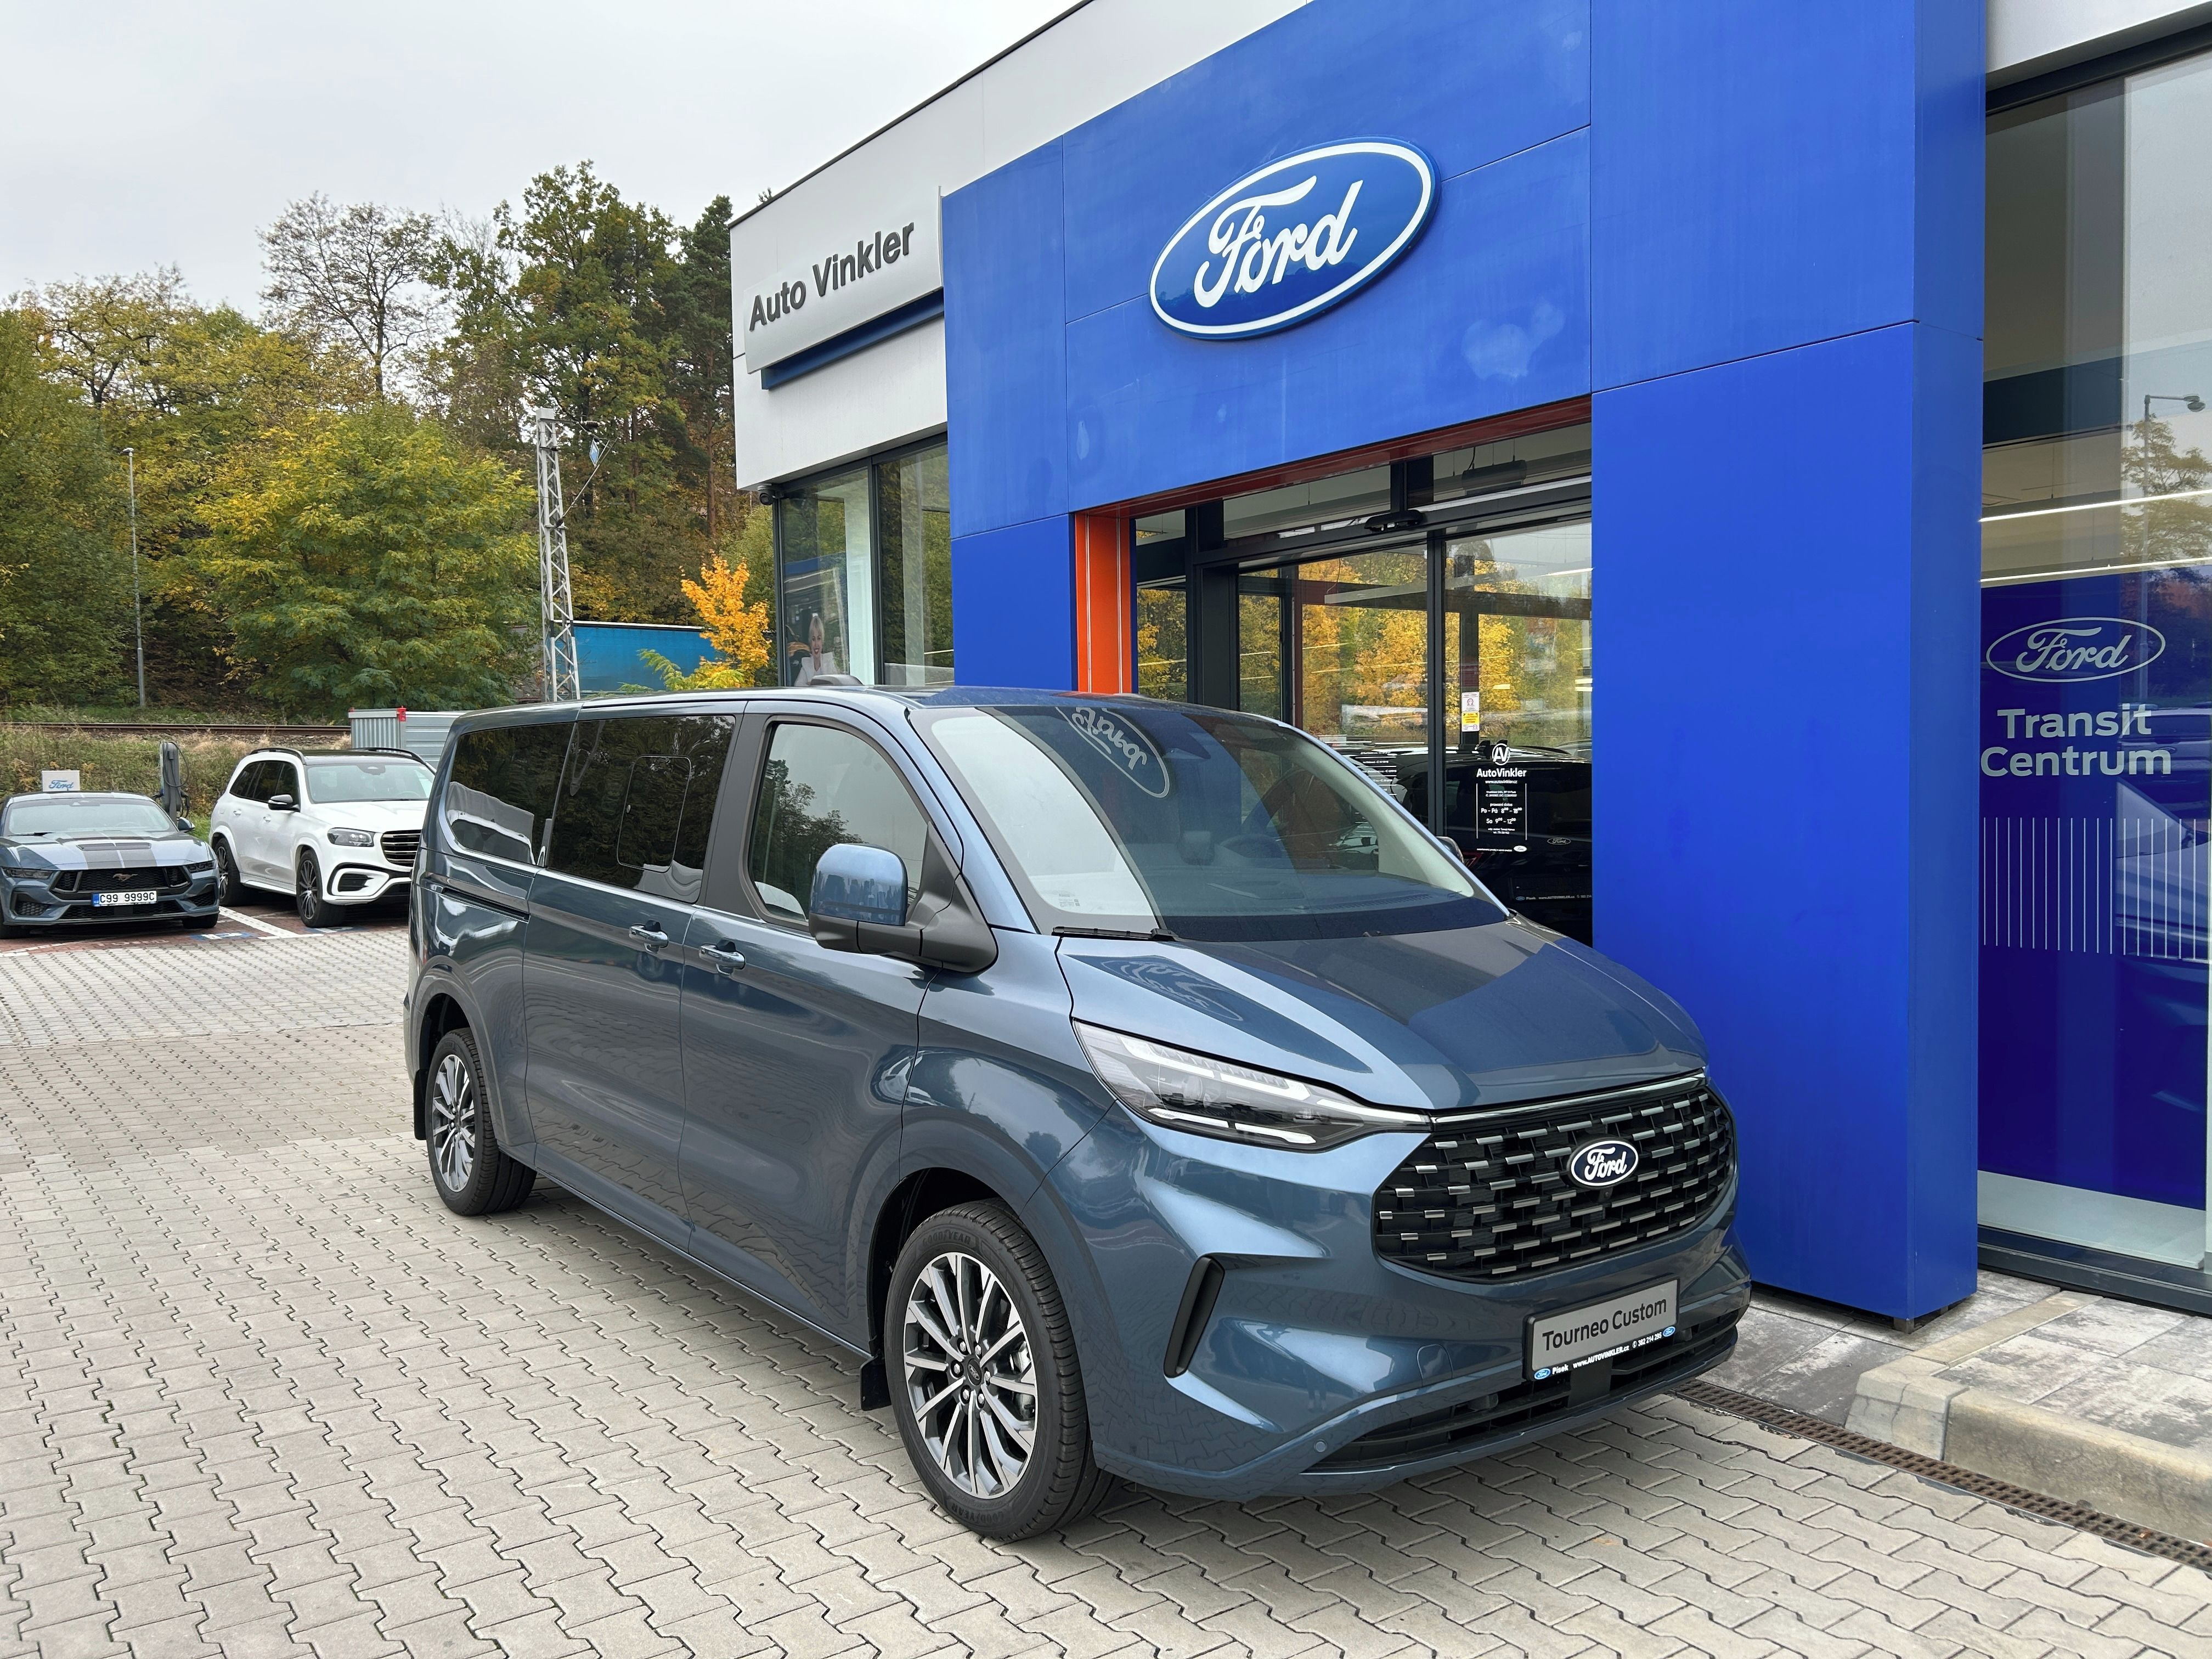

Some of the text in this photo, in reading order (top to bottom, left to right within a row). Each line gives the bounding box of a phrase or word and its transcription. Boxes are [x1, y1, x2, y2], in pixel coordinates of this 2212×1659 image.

[1194, 175, 1364, 308] Ford
[749, 222, 914, 332] Auto Vinkler
[2016, 627, 2132, 673] Ford
[1997, 703, 2152, 738] Transit
[1476, 768, 1527, 777] AutoVinkler
[1980, 746, 2171, 777] Centrum
[48, 780, 74, 789] Ford
[100, 893, 155, 903] C99 9999C
[1584, 1147, 1627, 1181] Ford
[1542, 1299, 1667, 1351] Tourneo Custom
[1572, 1345, 1629, 1369] www.AUTOVINKLER.cz
[1646, 1335, 1654, 1344] 214
